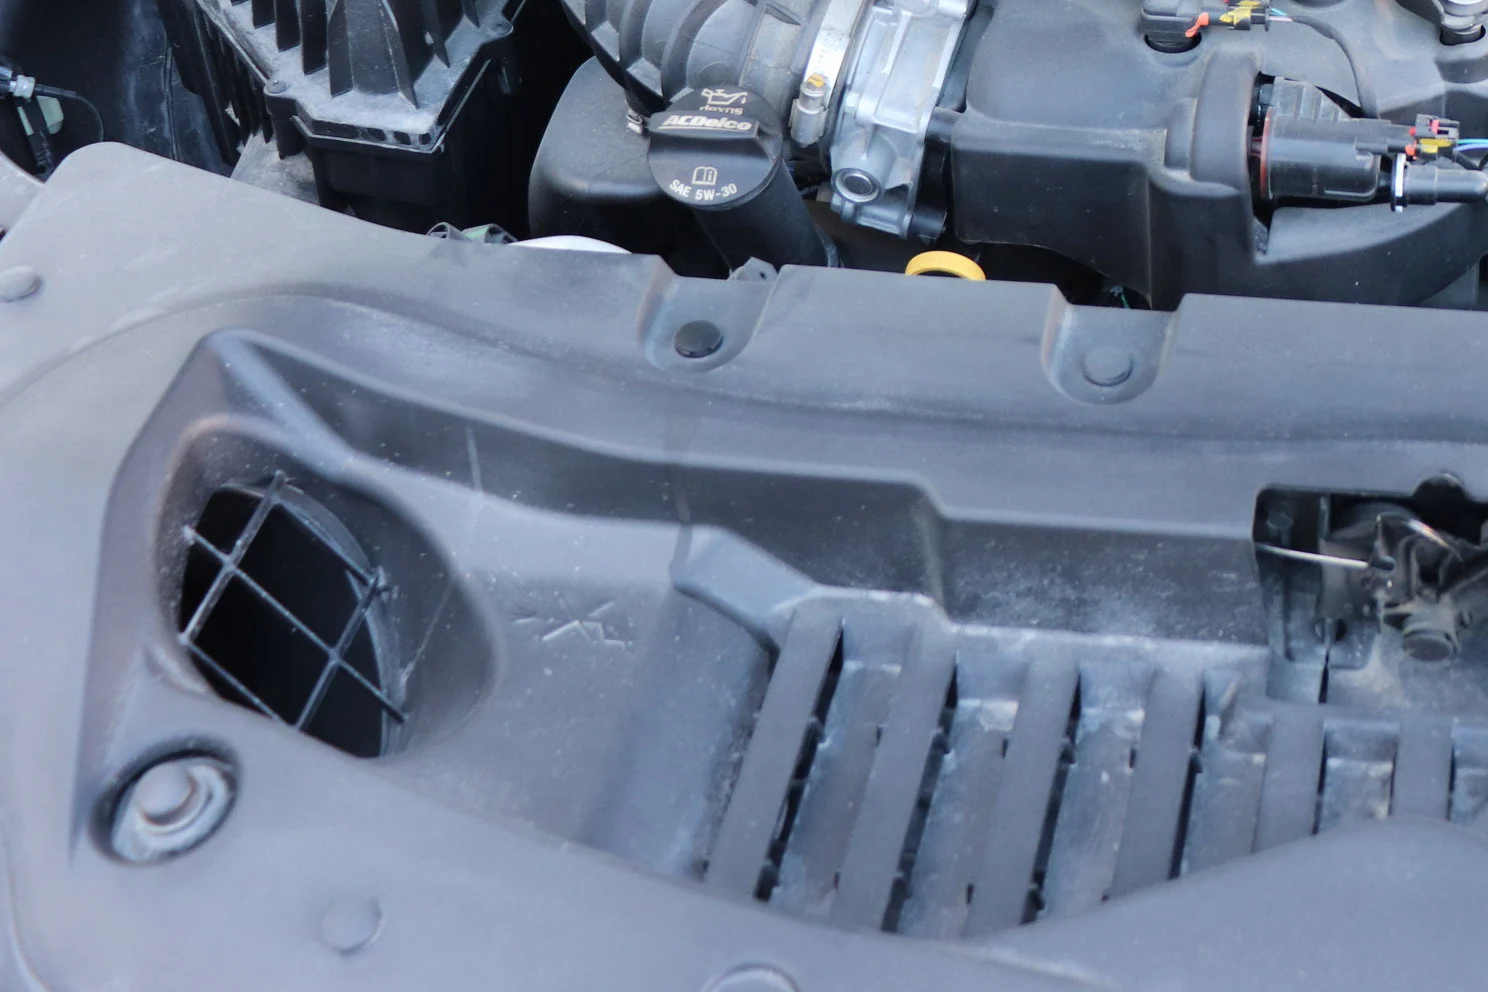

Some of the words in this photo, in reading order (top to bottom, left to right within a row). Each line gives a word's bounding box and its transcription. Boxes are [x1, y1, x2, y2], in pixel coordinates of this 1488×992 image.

[662, 114, 752, 130] ACDelco
[669, 179, 692, 198] SAE
[695, 183, 738, 200] 5W-30
